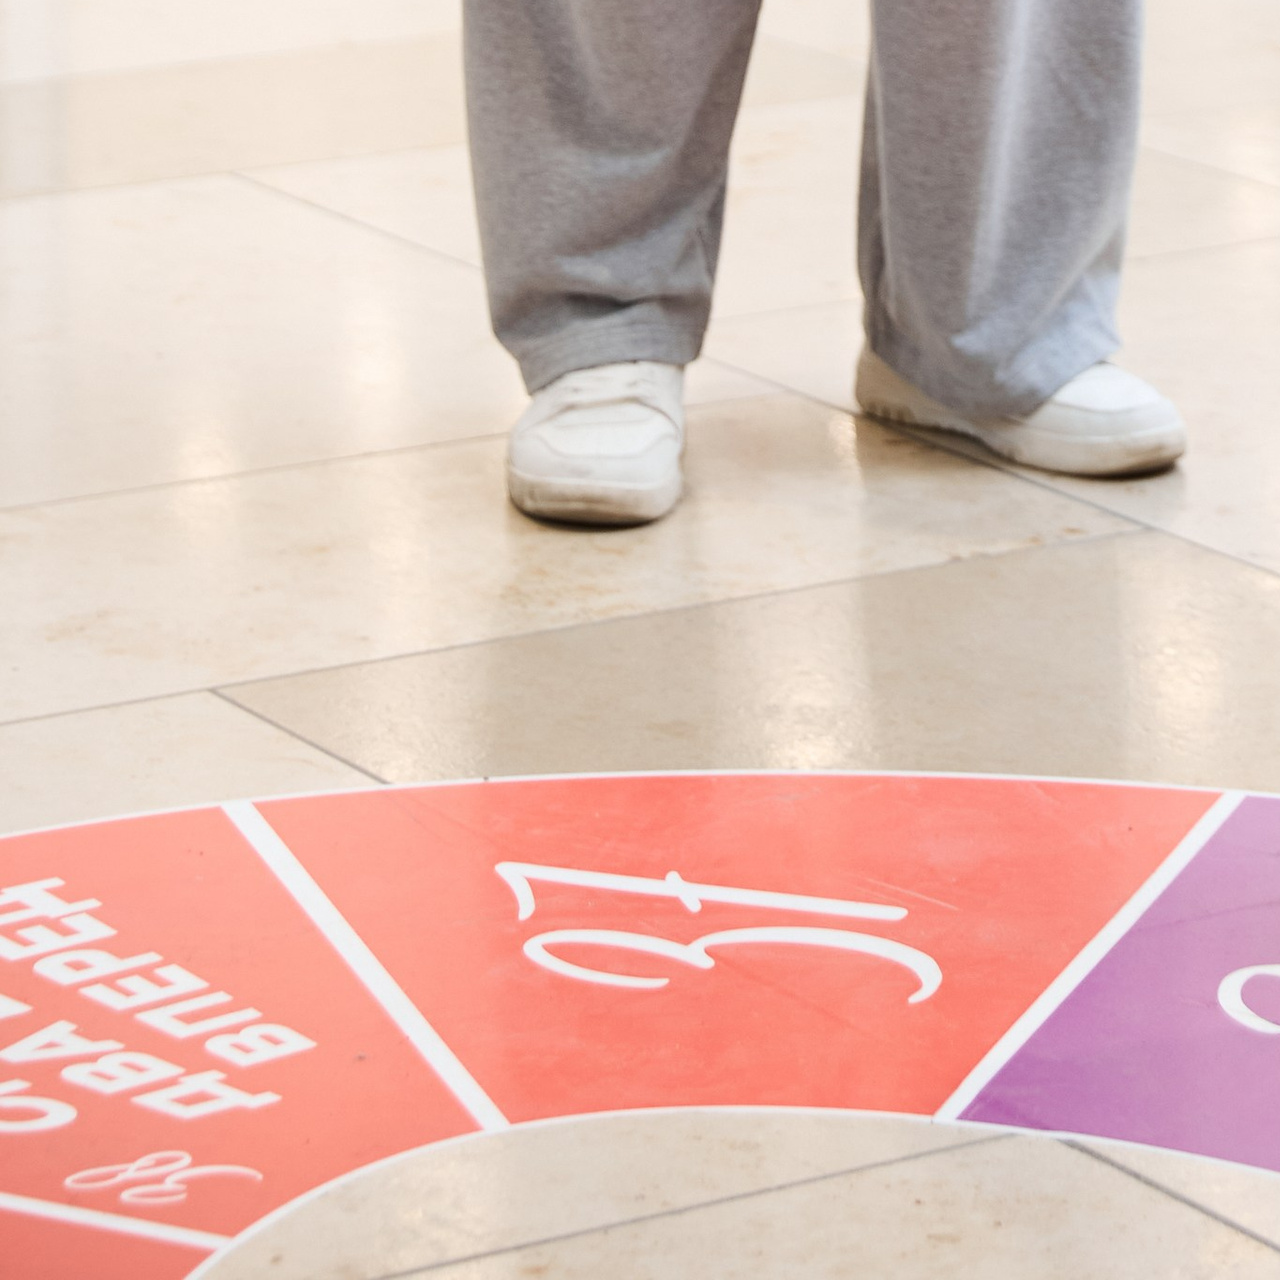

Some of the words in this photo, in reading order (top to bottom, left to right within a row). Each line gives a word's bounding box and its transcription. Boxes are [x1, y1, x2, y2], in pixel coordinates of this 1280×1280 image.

[495, 861, 942, 1004] 37
[0, 1020, 282, 1120] ДВА
[64, 1150, 263, 1204] 38
